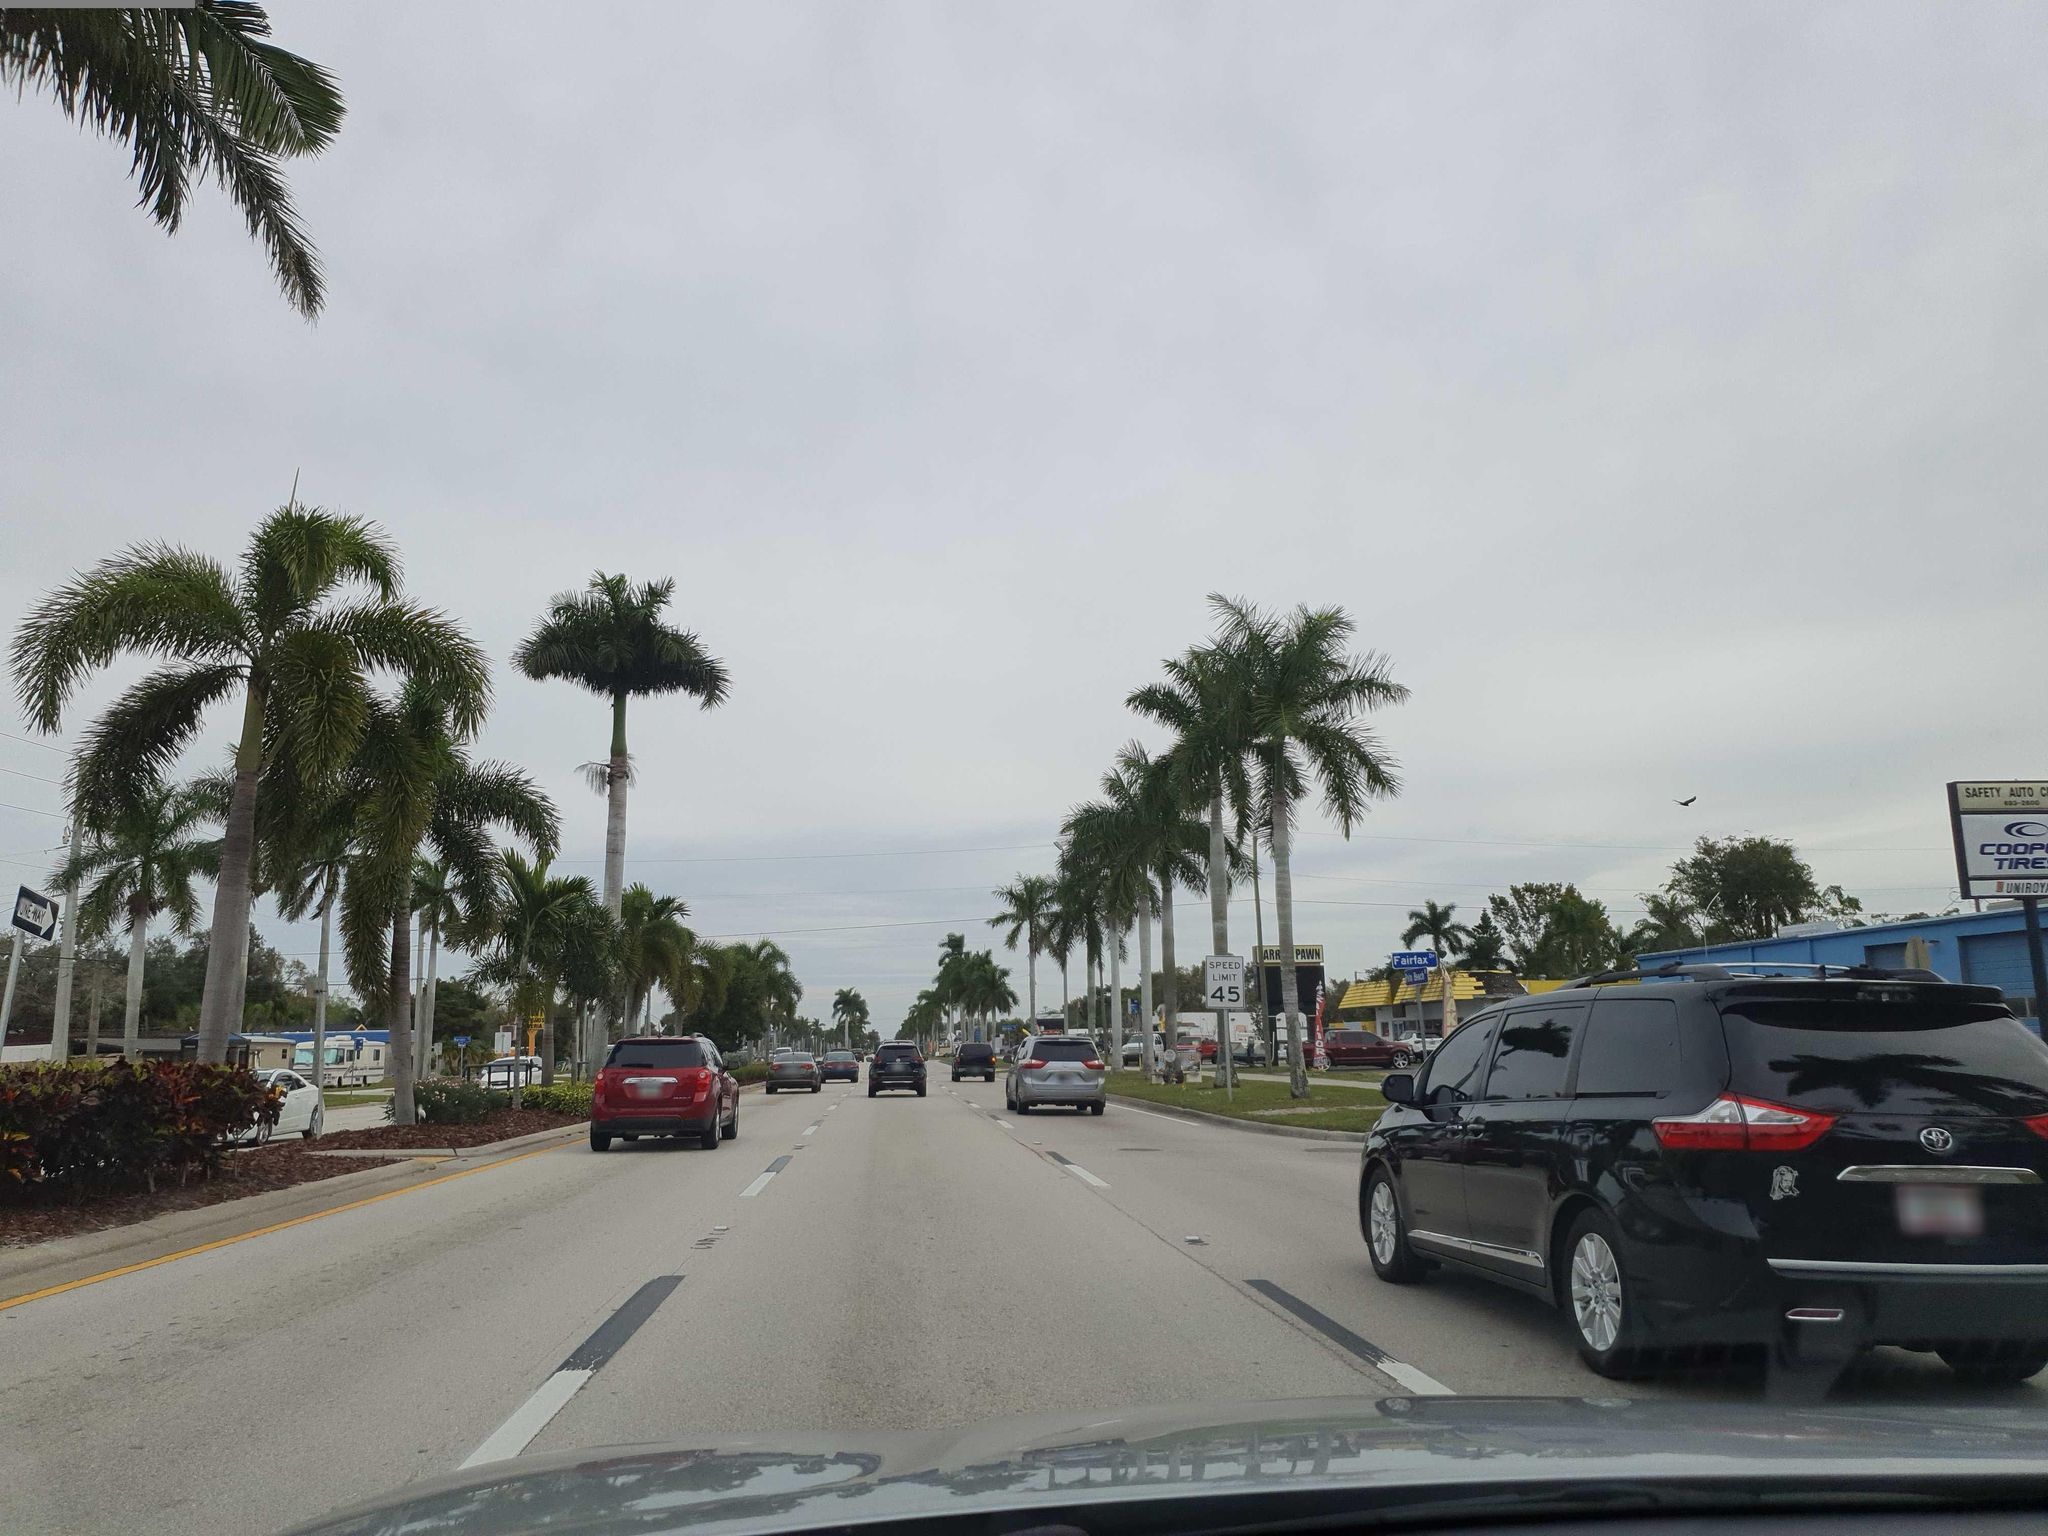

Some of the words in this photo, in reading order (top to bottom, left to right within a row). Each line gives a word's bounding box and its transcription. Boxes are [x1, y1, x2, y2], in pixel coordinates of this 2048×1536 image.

[1965, 787, 2001, 798] SAFETY
[2009, 787, 2034, 797] AUTO
[1994, 857, 2048, 870] TIRE
[1295, 948, 1321, 960] PAWN
[1209, 961, 1241, 970] SPEED
[1393, 955, 1429, 966] Fairfax
[1212, 973, 1238, 982] LIMIT
[1210, 986, 1241, 1002] 45
